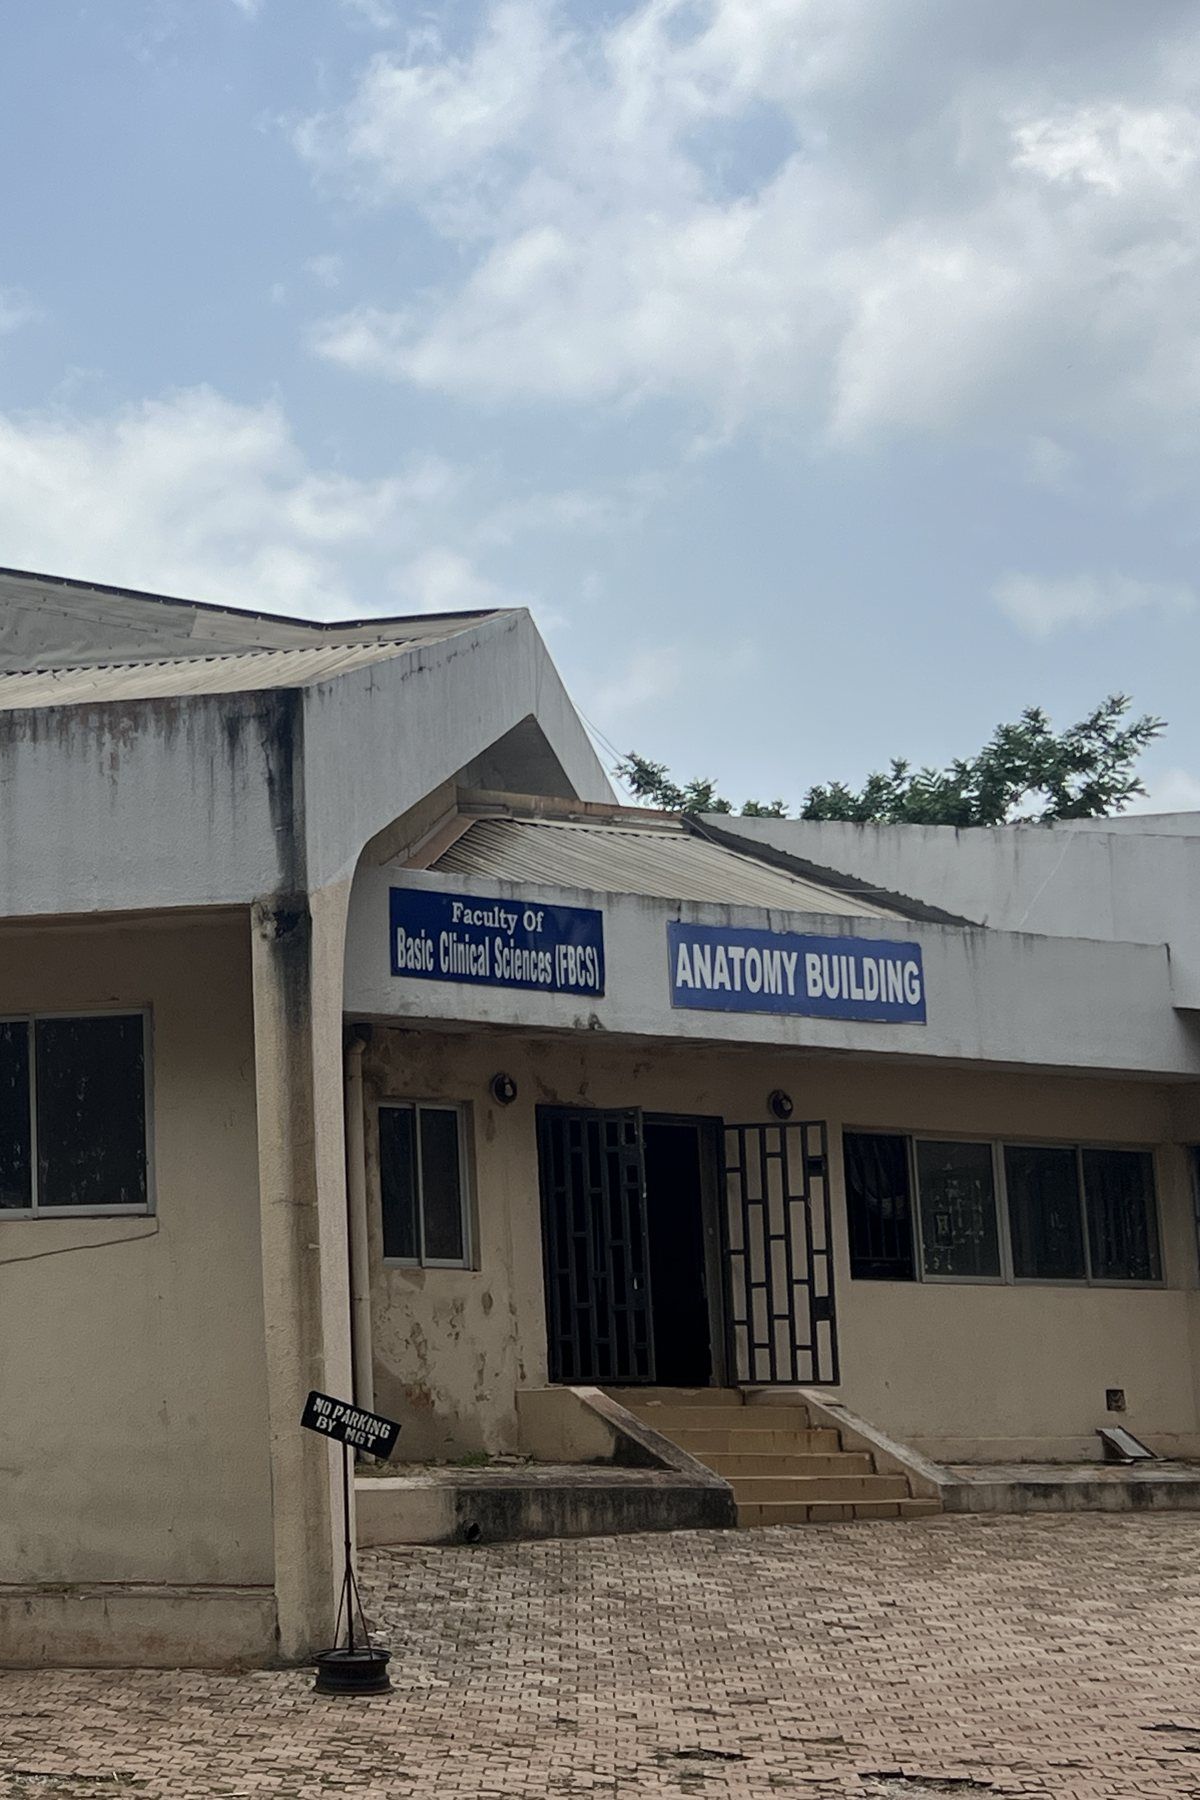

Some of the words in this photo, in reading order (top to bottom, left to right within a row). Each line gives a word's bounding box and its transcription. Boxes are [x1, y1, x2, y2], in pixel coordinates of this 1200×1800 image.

[452, 902, 518, 935] Faculty
[523, 910, 544, 932] Of
[397, 927, 434, 972] Basic
[440, 931, 490, 977] Clinical
[494, 936, 552, 984] Sciences
[555, 944, 599, 990] (FBCS)
[676, 943, 798, 996] ANATOMY
[805, 953, 921, 1005] BUILDING
[313, 1397, 332, 1415] NO
[332, 1405, 391, 1439] PARKING
[316, 1416, 337, 1432] BY
[344, 1427, 376, 1448] MGT
